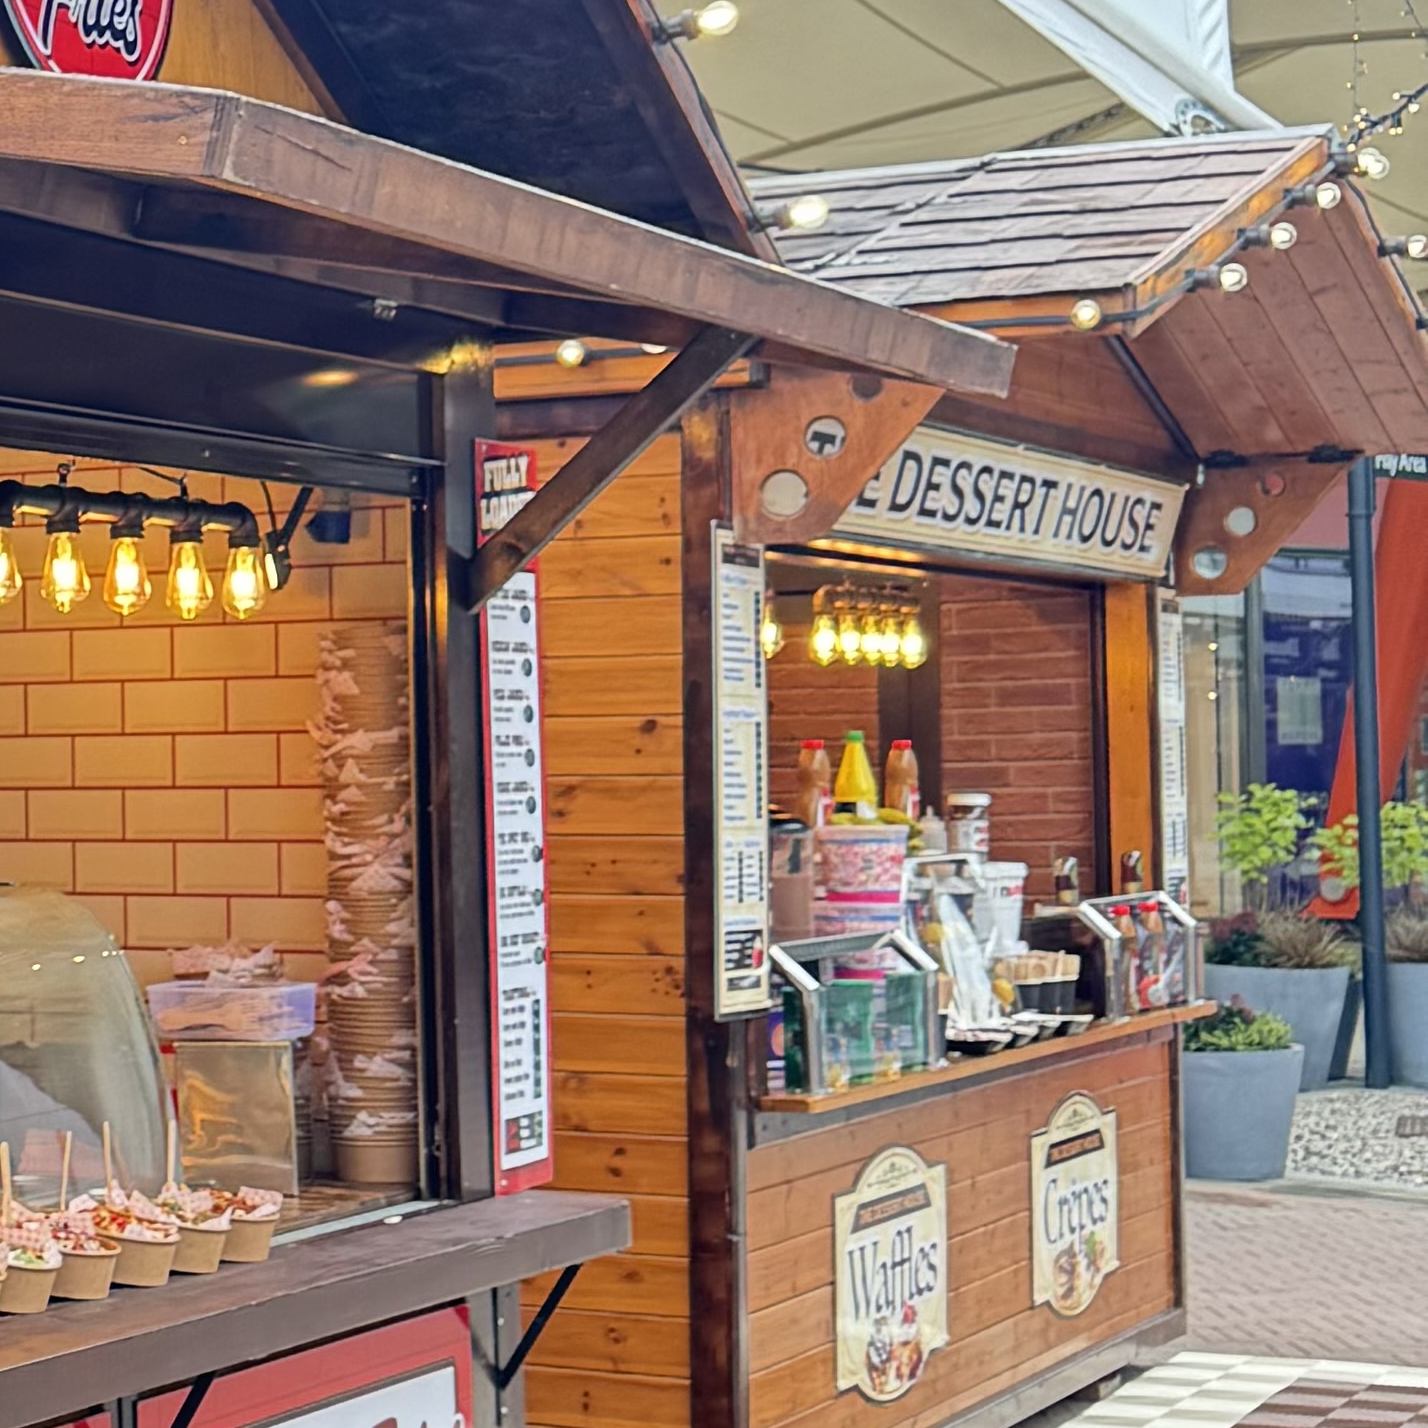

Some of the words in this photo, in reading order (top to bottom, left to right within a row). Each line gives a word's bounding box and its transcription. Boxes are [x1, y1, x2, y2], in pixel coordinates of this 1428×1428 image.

[483, 454, 529, 493] FULLY
[887, 449, 1059, 537] DESSERT
[1051, 476, 1165, 555] HOUSE
[848, 1224, 938, 1322] Waffles
